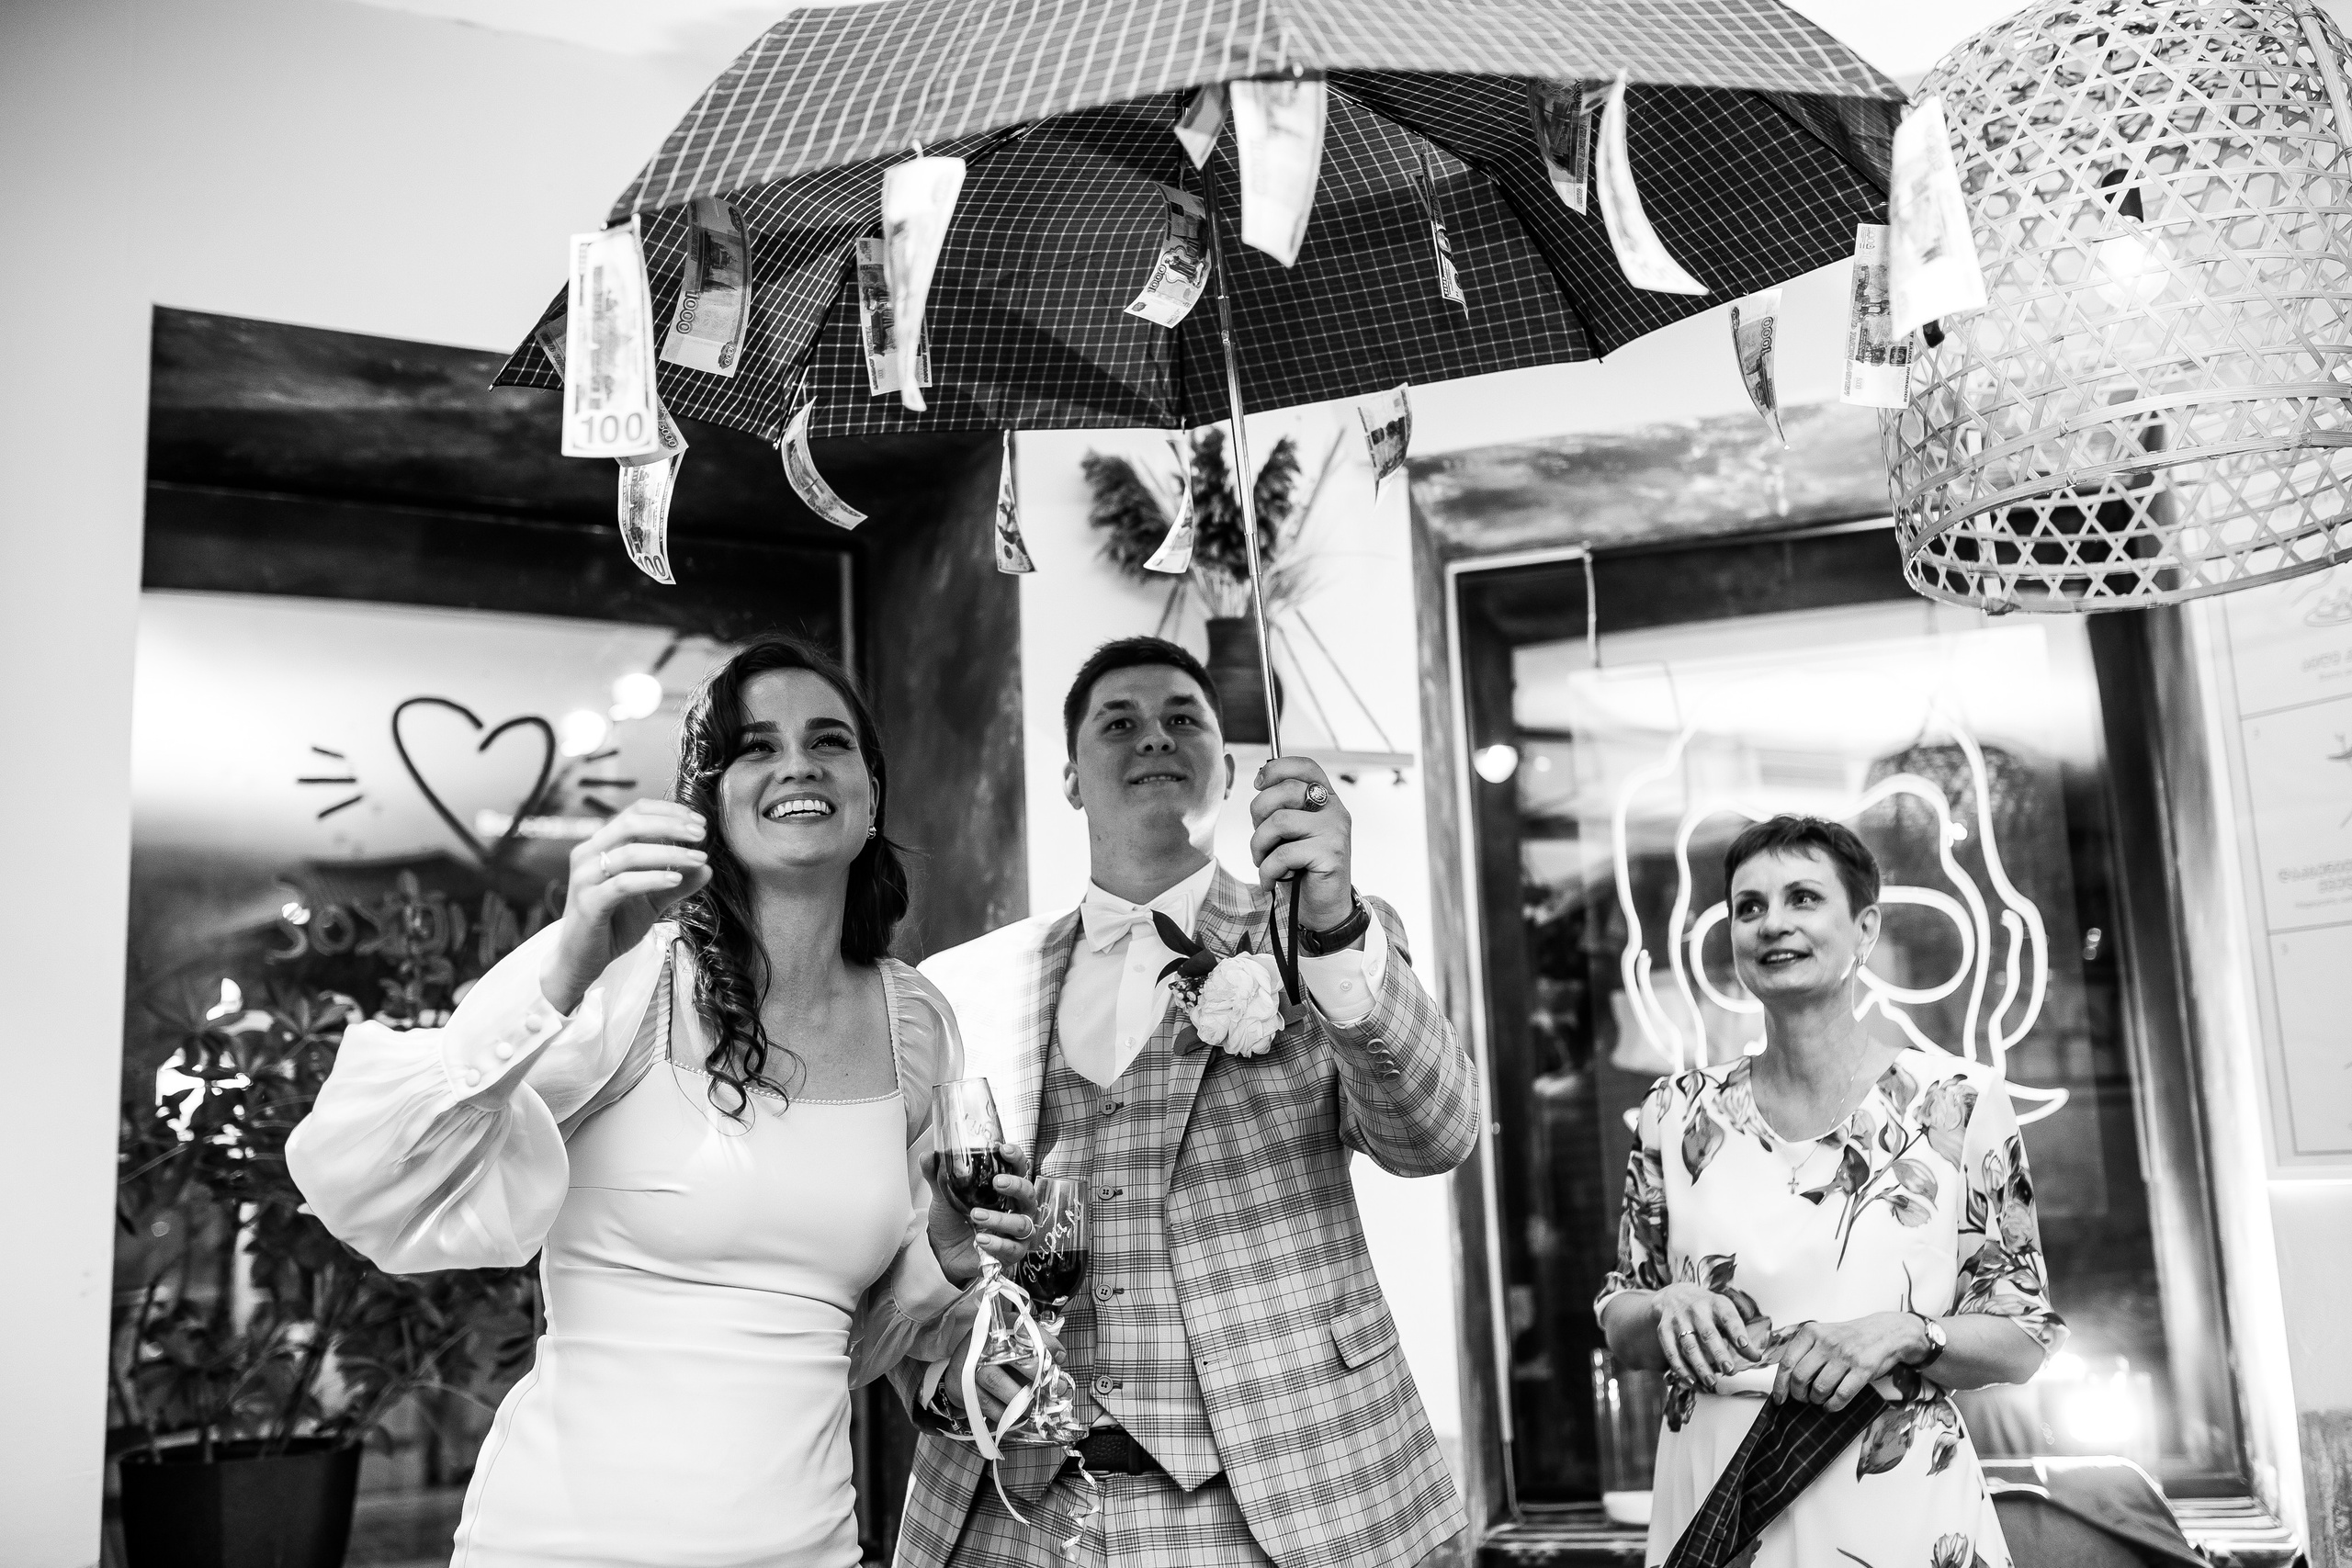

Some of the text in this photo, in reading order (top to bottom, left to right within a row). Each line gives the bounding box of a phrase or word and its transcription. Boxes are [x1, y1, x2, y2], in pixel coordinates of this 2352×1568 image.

[1148, 264, 1167, 293] 1000
[675, 290, 700, 334] 1000
[1760, 316, 1774, 356] 1000
[724, 345, 736, 367] 1000
[581, 412, 644, 444] 100
[636, 555, 666, 578] 100
